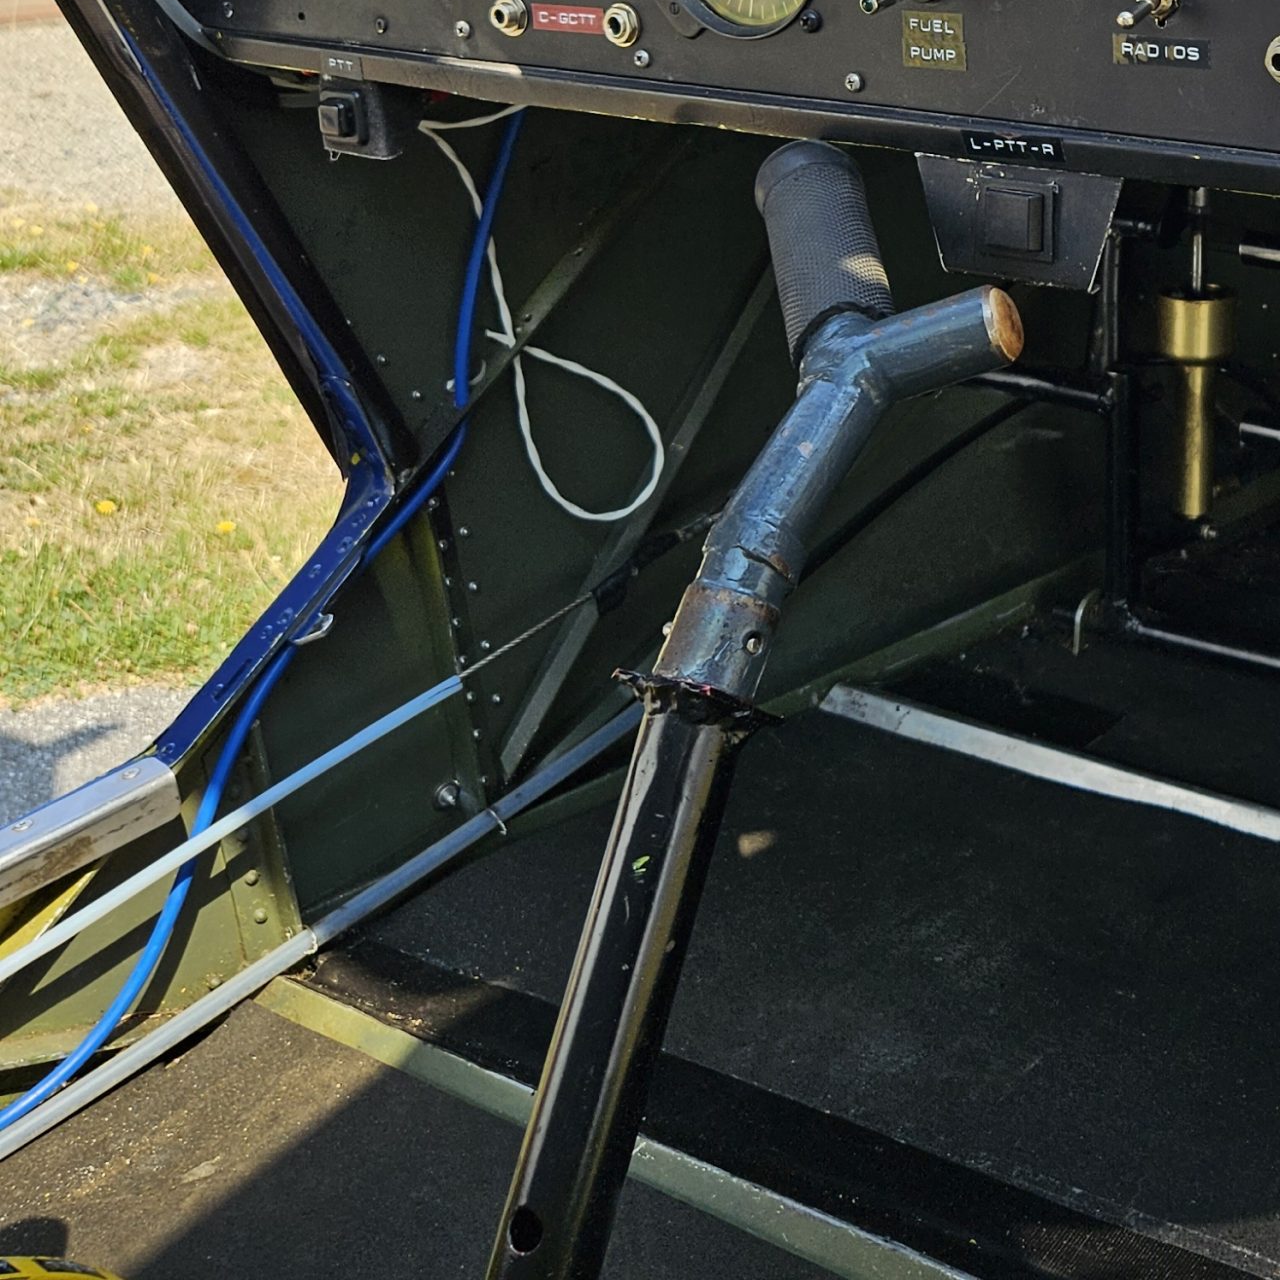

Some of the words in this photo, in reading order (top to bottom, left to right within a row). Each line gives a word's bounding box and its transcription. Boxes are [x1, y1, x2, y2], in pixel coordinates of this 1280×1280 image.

[539, 11, 597, 26] C-GCTT
[909, 19, 954, 35] FUEL
[910, 47, 957, 62] PUMP
[1121, 42, 1200, 61] RADIOS
[971, 137, 1055, 156] L-PTT-R
